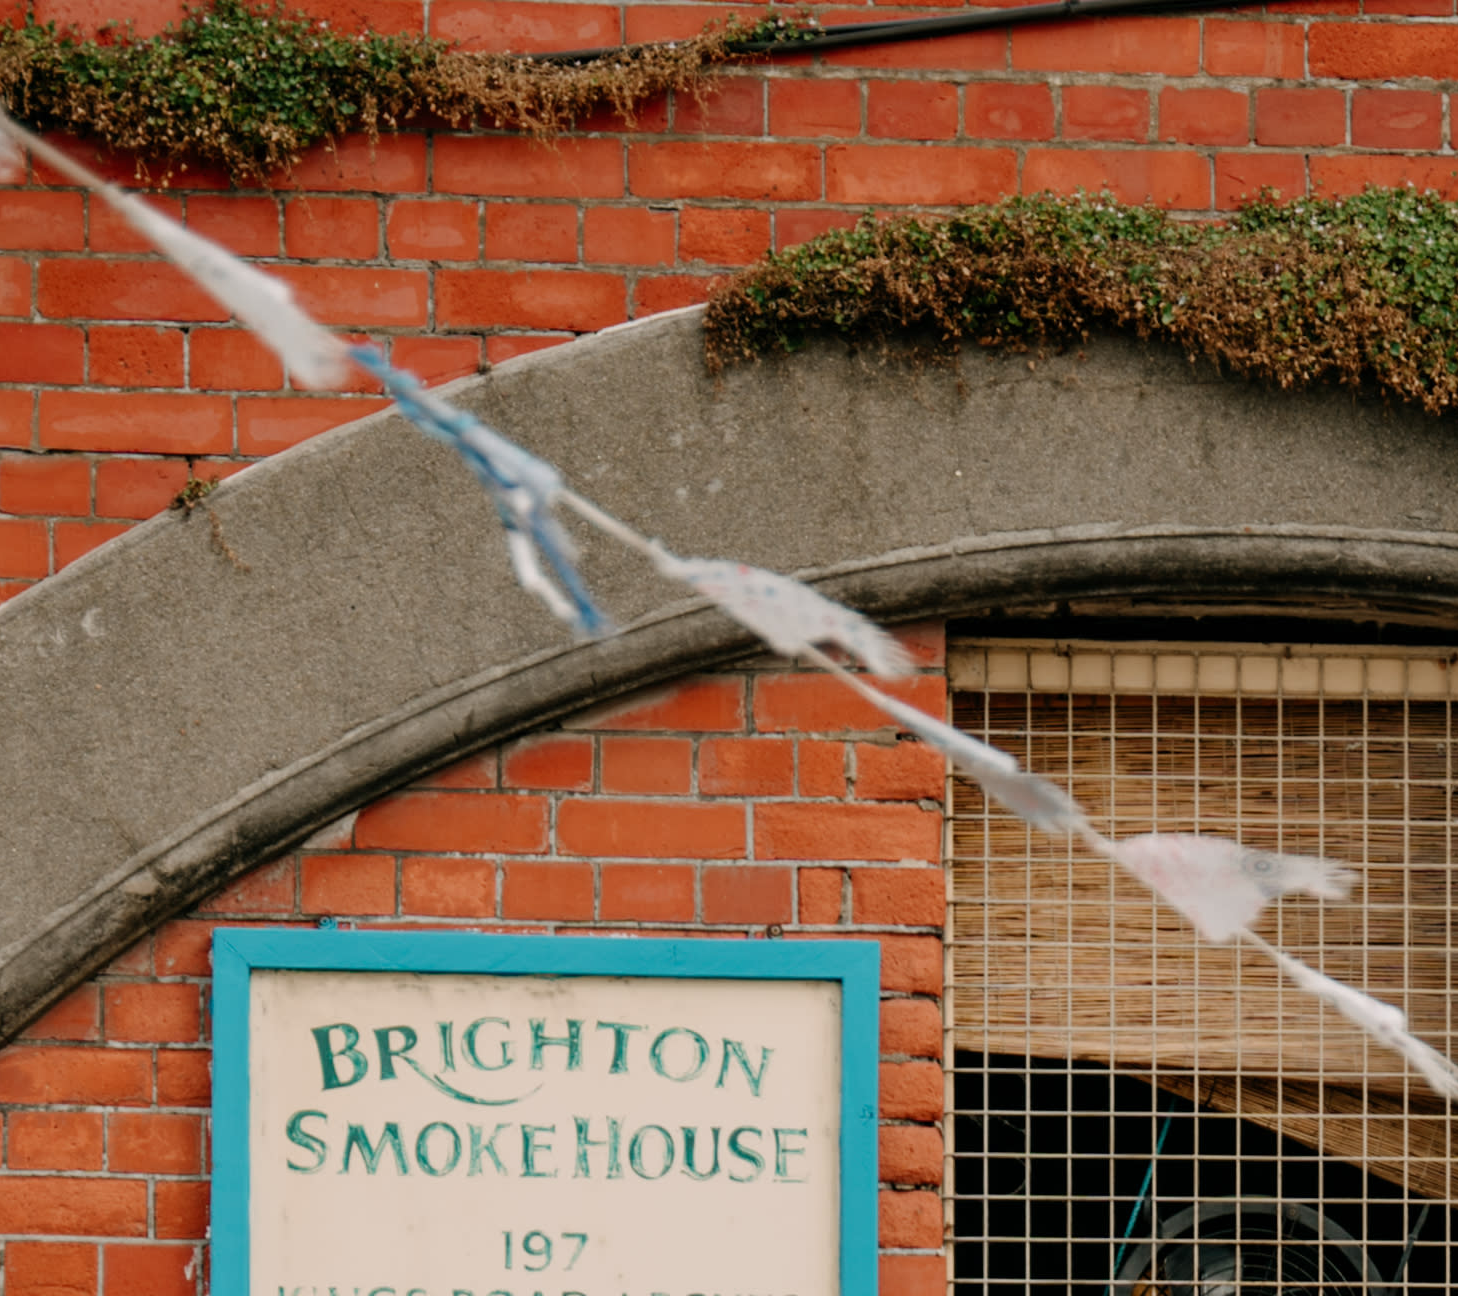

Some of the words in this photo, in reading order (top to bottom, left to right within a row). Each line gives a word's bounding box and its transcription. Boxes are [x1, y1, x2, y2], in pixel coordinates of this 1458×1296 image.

[311, 1017, 774, 1106] BRIGHTON
[286, 1110, 809, 1182] SMOKEHOUSE
[502, 1230, 589, 1271] 197
